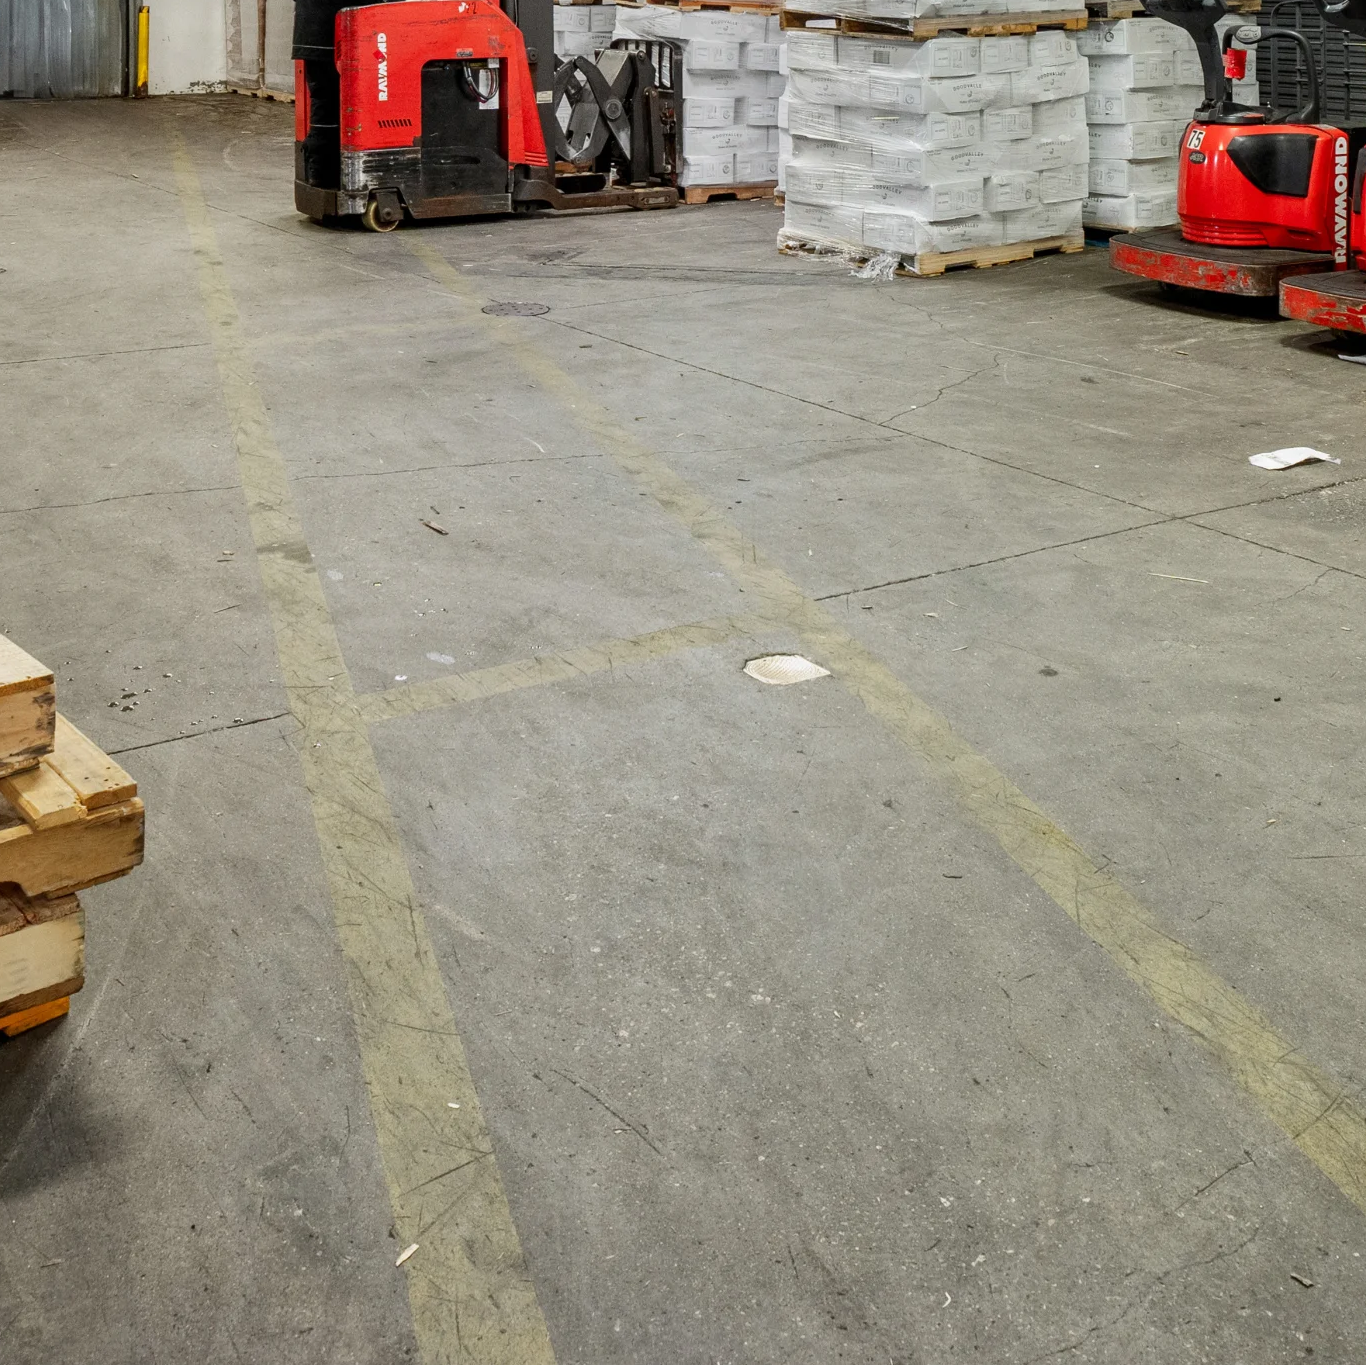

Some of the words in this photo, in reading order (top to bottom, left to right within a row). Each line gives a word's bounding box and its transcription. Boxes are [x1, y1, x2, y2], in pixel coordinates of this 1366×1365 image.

[377, 33, 388, 102] RAYMND
[952, 83, 982, 91] GOODVALLE
[1188, 129, 1204, 149] 75
[815, 143, 849, 151] GOODVALLEY
[951, 151, 985, 161] GOODVALLEY
[1334, 136, 1348, 264] RAYMOND
[946, 223, 980, 232] GOODVALLEY
